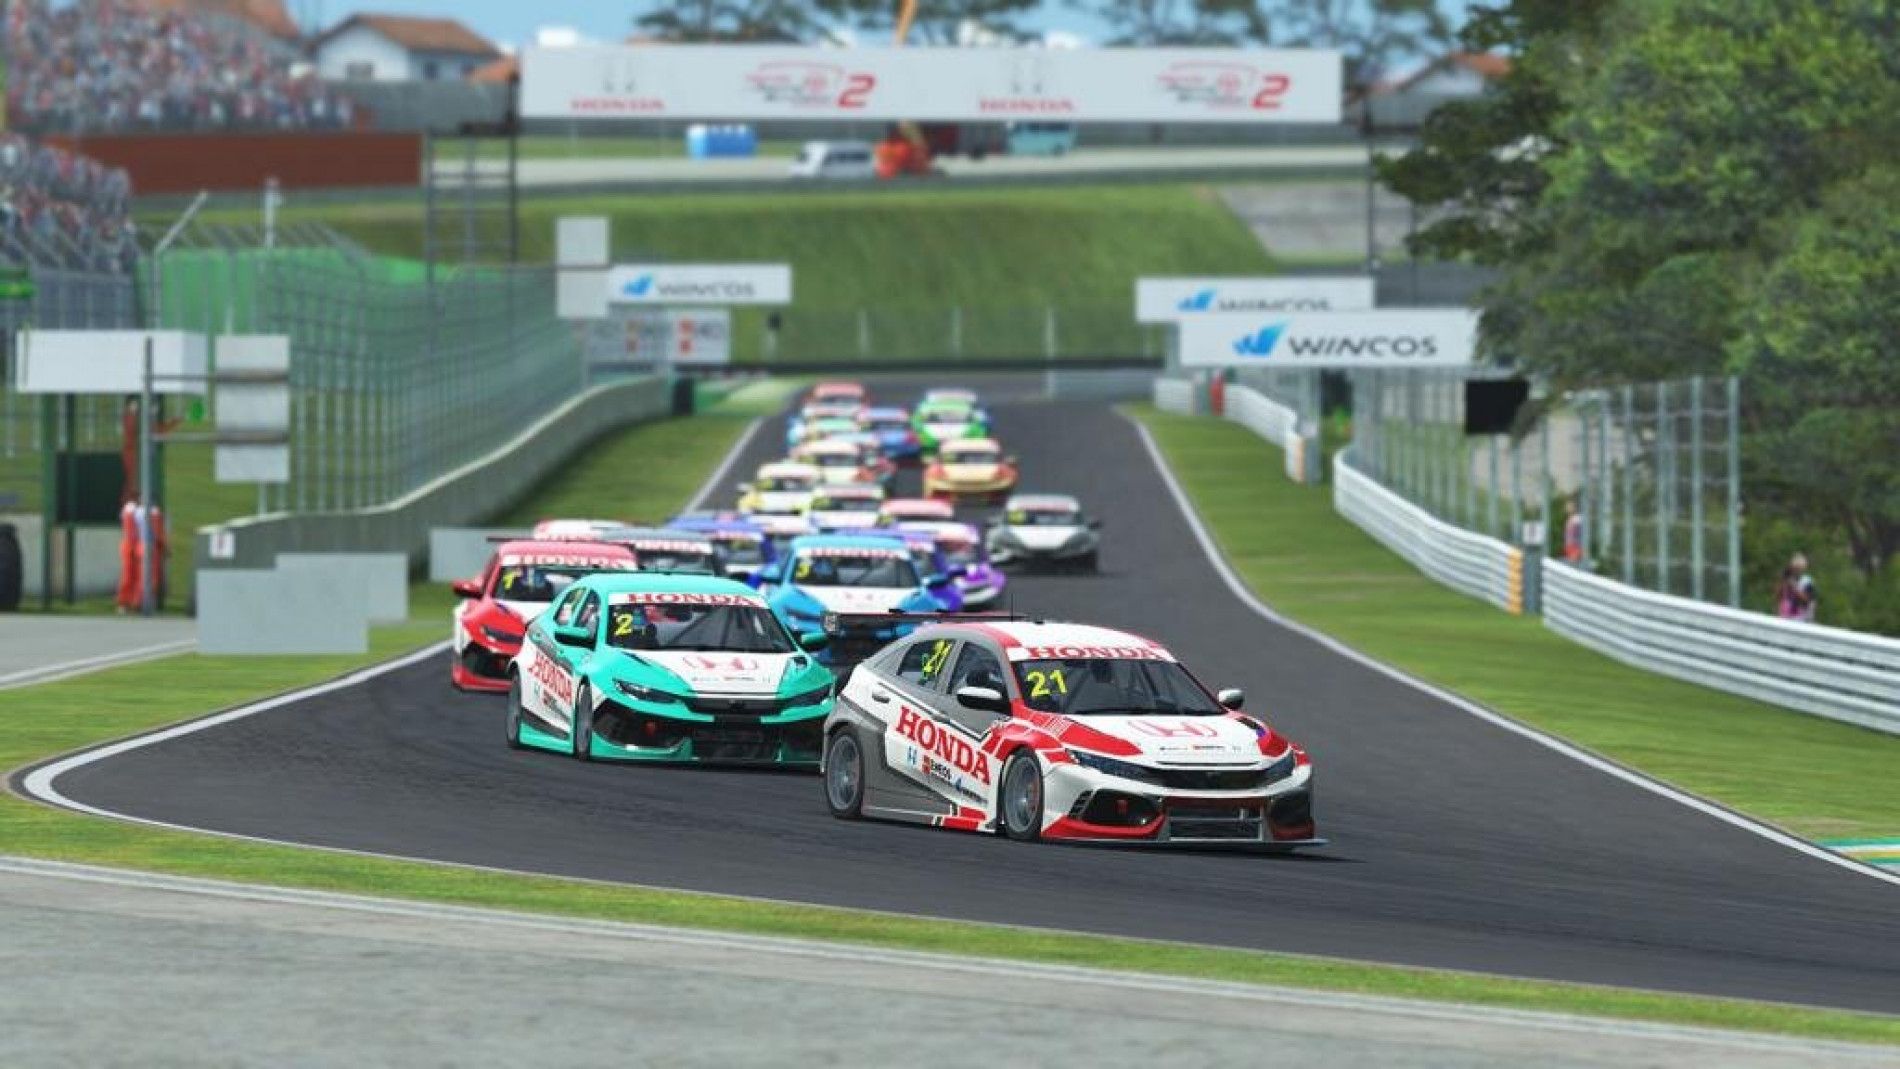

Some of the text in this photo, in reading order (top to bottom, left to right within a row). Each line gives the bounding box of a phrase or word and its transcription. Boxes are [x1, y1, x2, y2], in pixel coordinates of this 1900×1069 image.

[837, 73, 876, 109] 2
[1251, 74, 1291, 109] 2
[1288, 335, 1438, 357] WINCOS
[628, 593, 760, 607] HONDA
[614, 613, 633, 636] 2
[1028, 647, 1160, 659] HONDA
[1026, 669, 1068, 698] 21
[896, 705, 991, 785] HONDA
